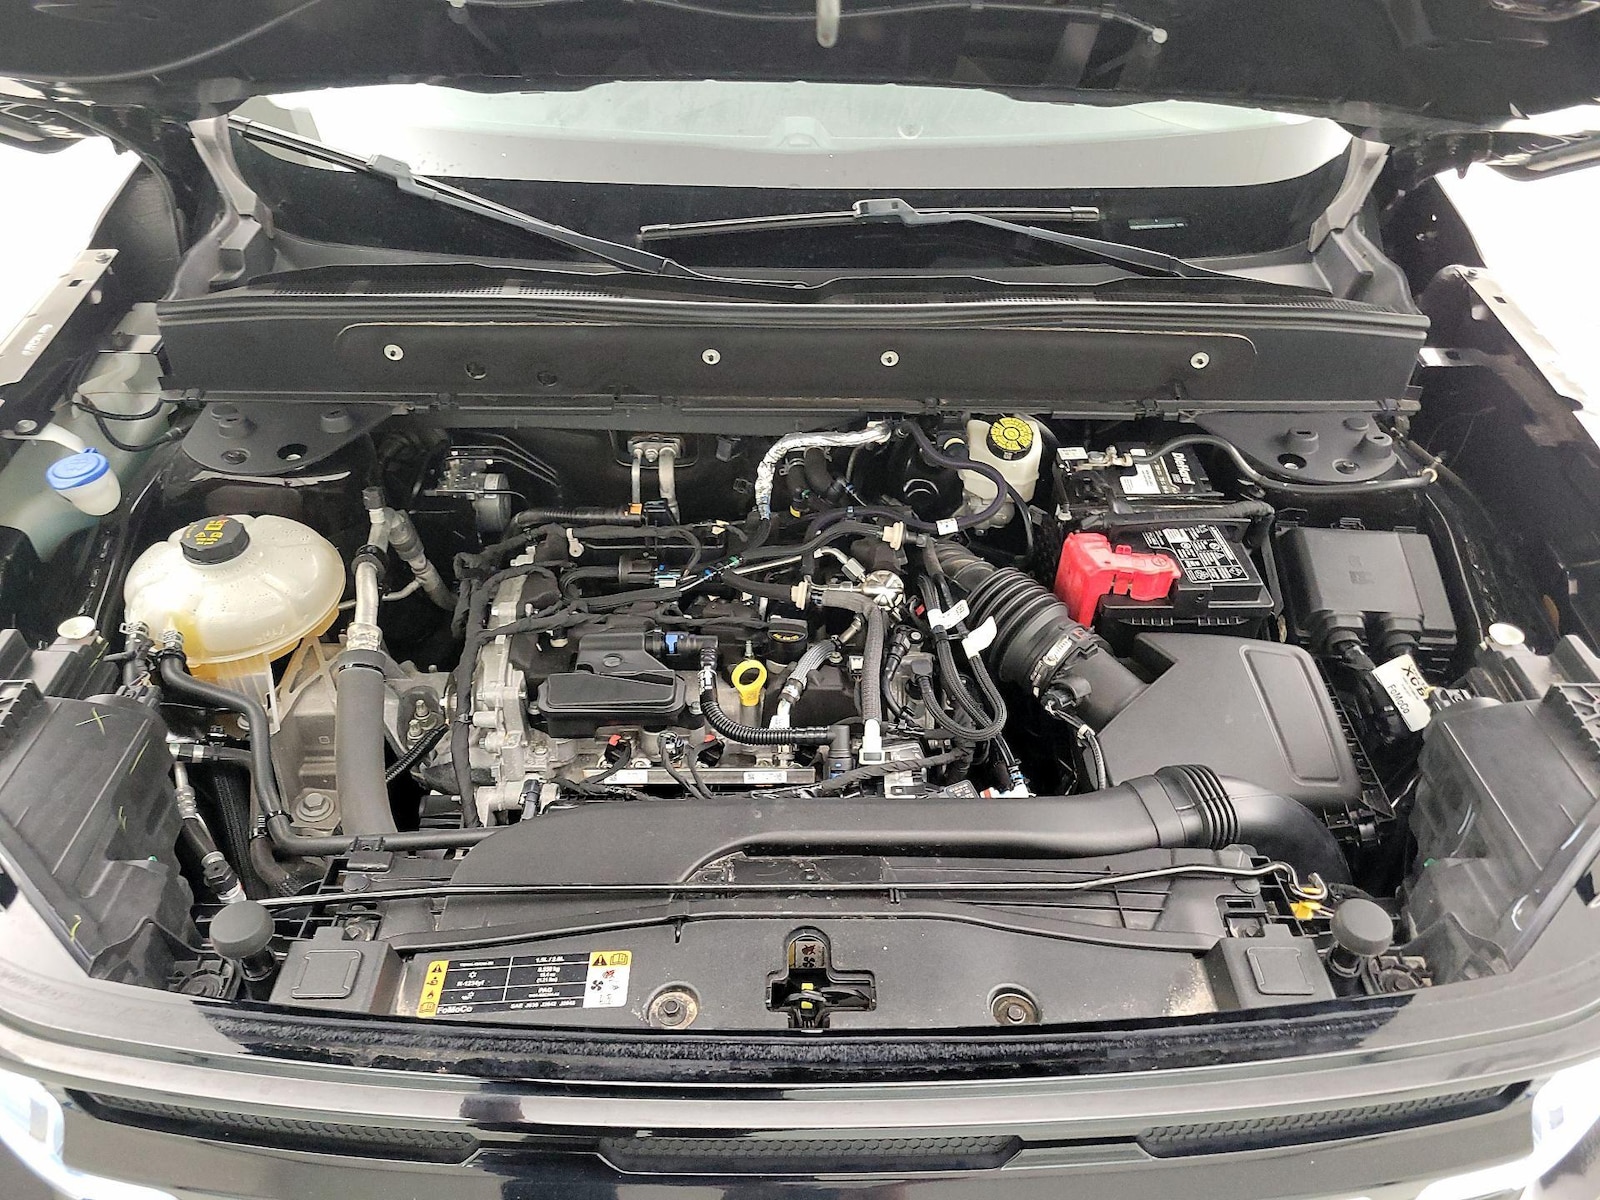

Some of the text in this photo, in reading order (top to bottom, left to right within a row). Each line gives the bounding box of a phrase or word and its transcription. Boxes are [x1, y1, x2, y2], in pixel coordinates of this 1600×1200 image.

[1171, 452, 1195, 485] DieHard
[1387, 684, 1410, 714] FoMoCo
[437, 1005, 473, 1014] FoMoCo
